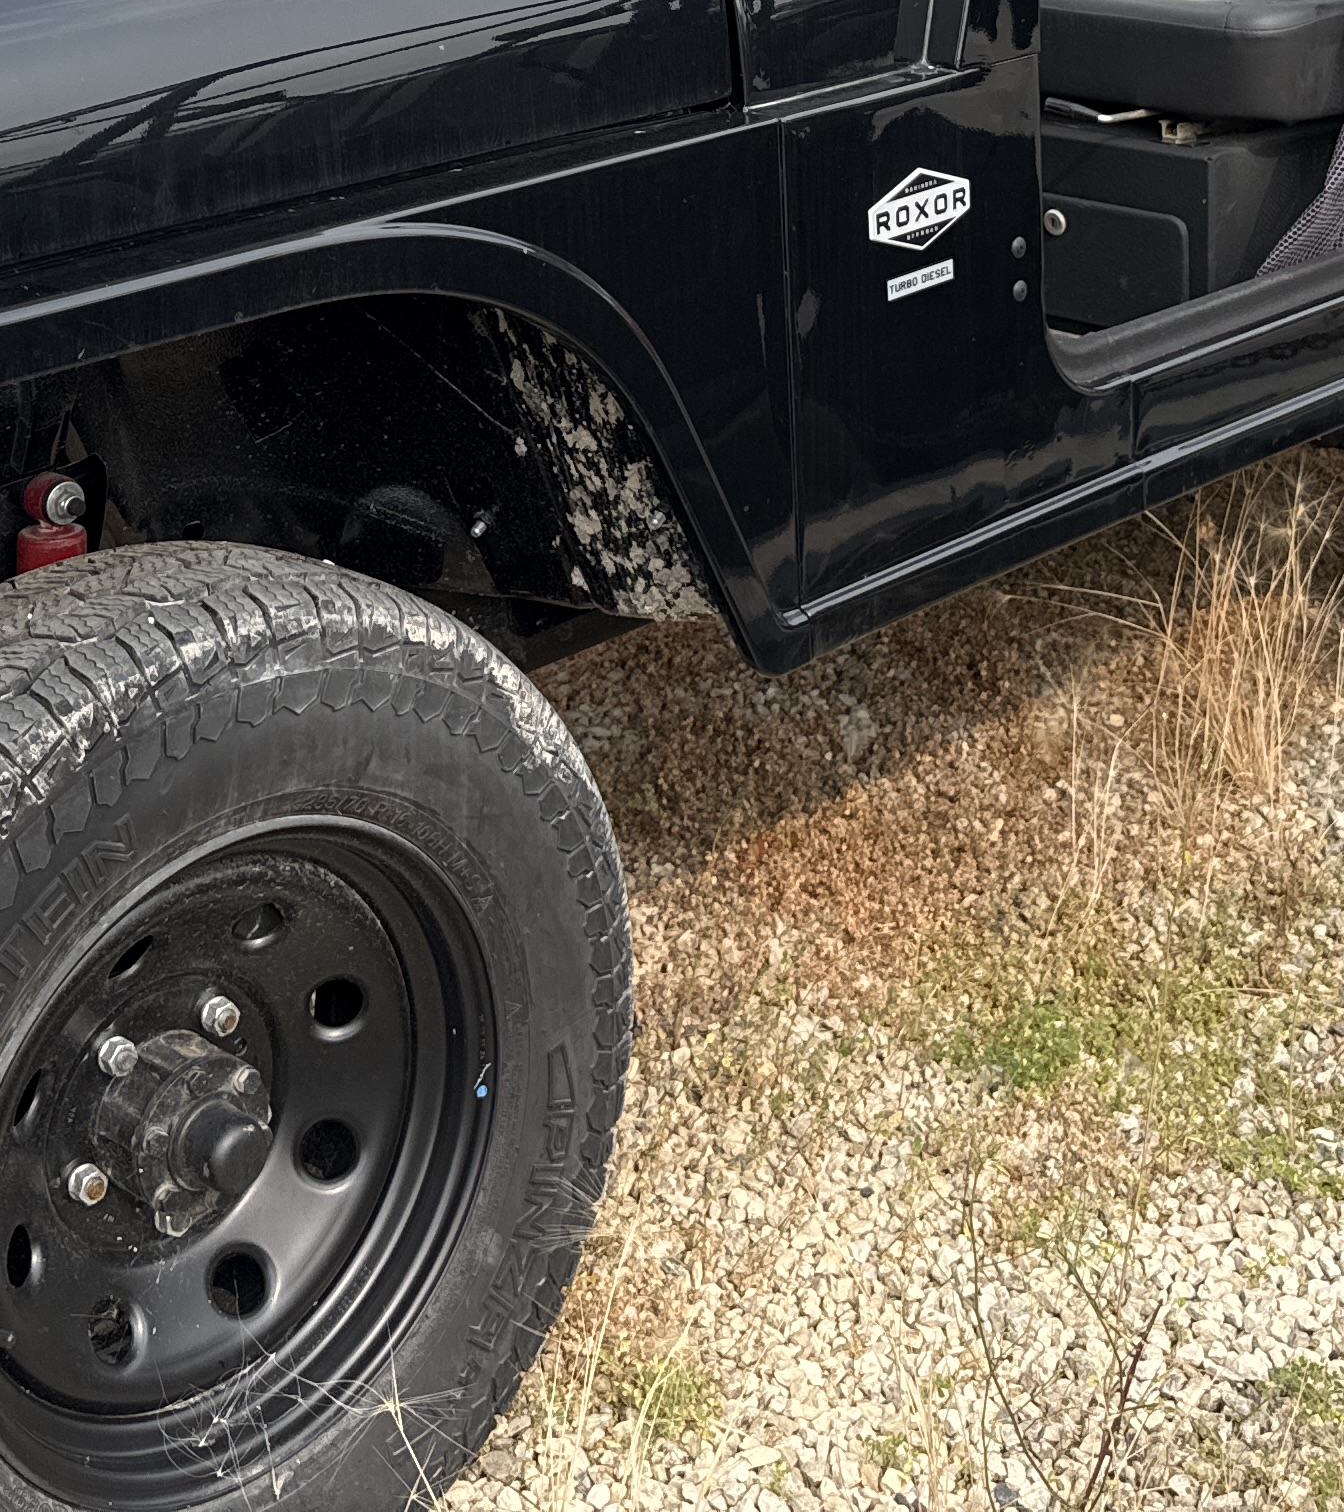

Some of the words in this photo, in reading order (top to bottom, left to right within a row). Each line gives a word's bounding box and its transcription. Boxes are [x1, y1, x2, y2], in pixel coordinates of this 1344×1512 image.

[875, 186, 967, 236] ROXOR
[889, 276, 919, 295] TURBO
[921, 265, 952, 284] DIESEL
